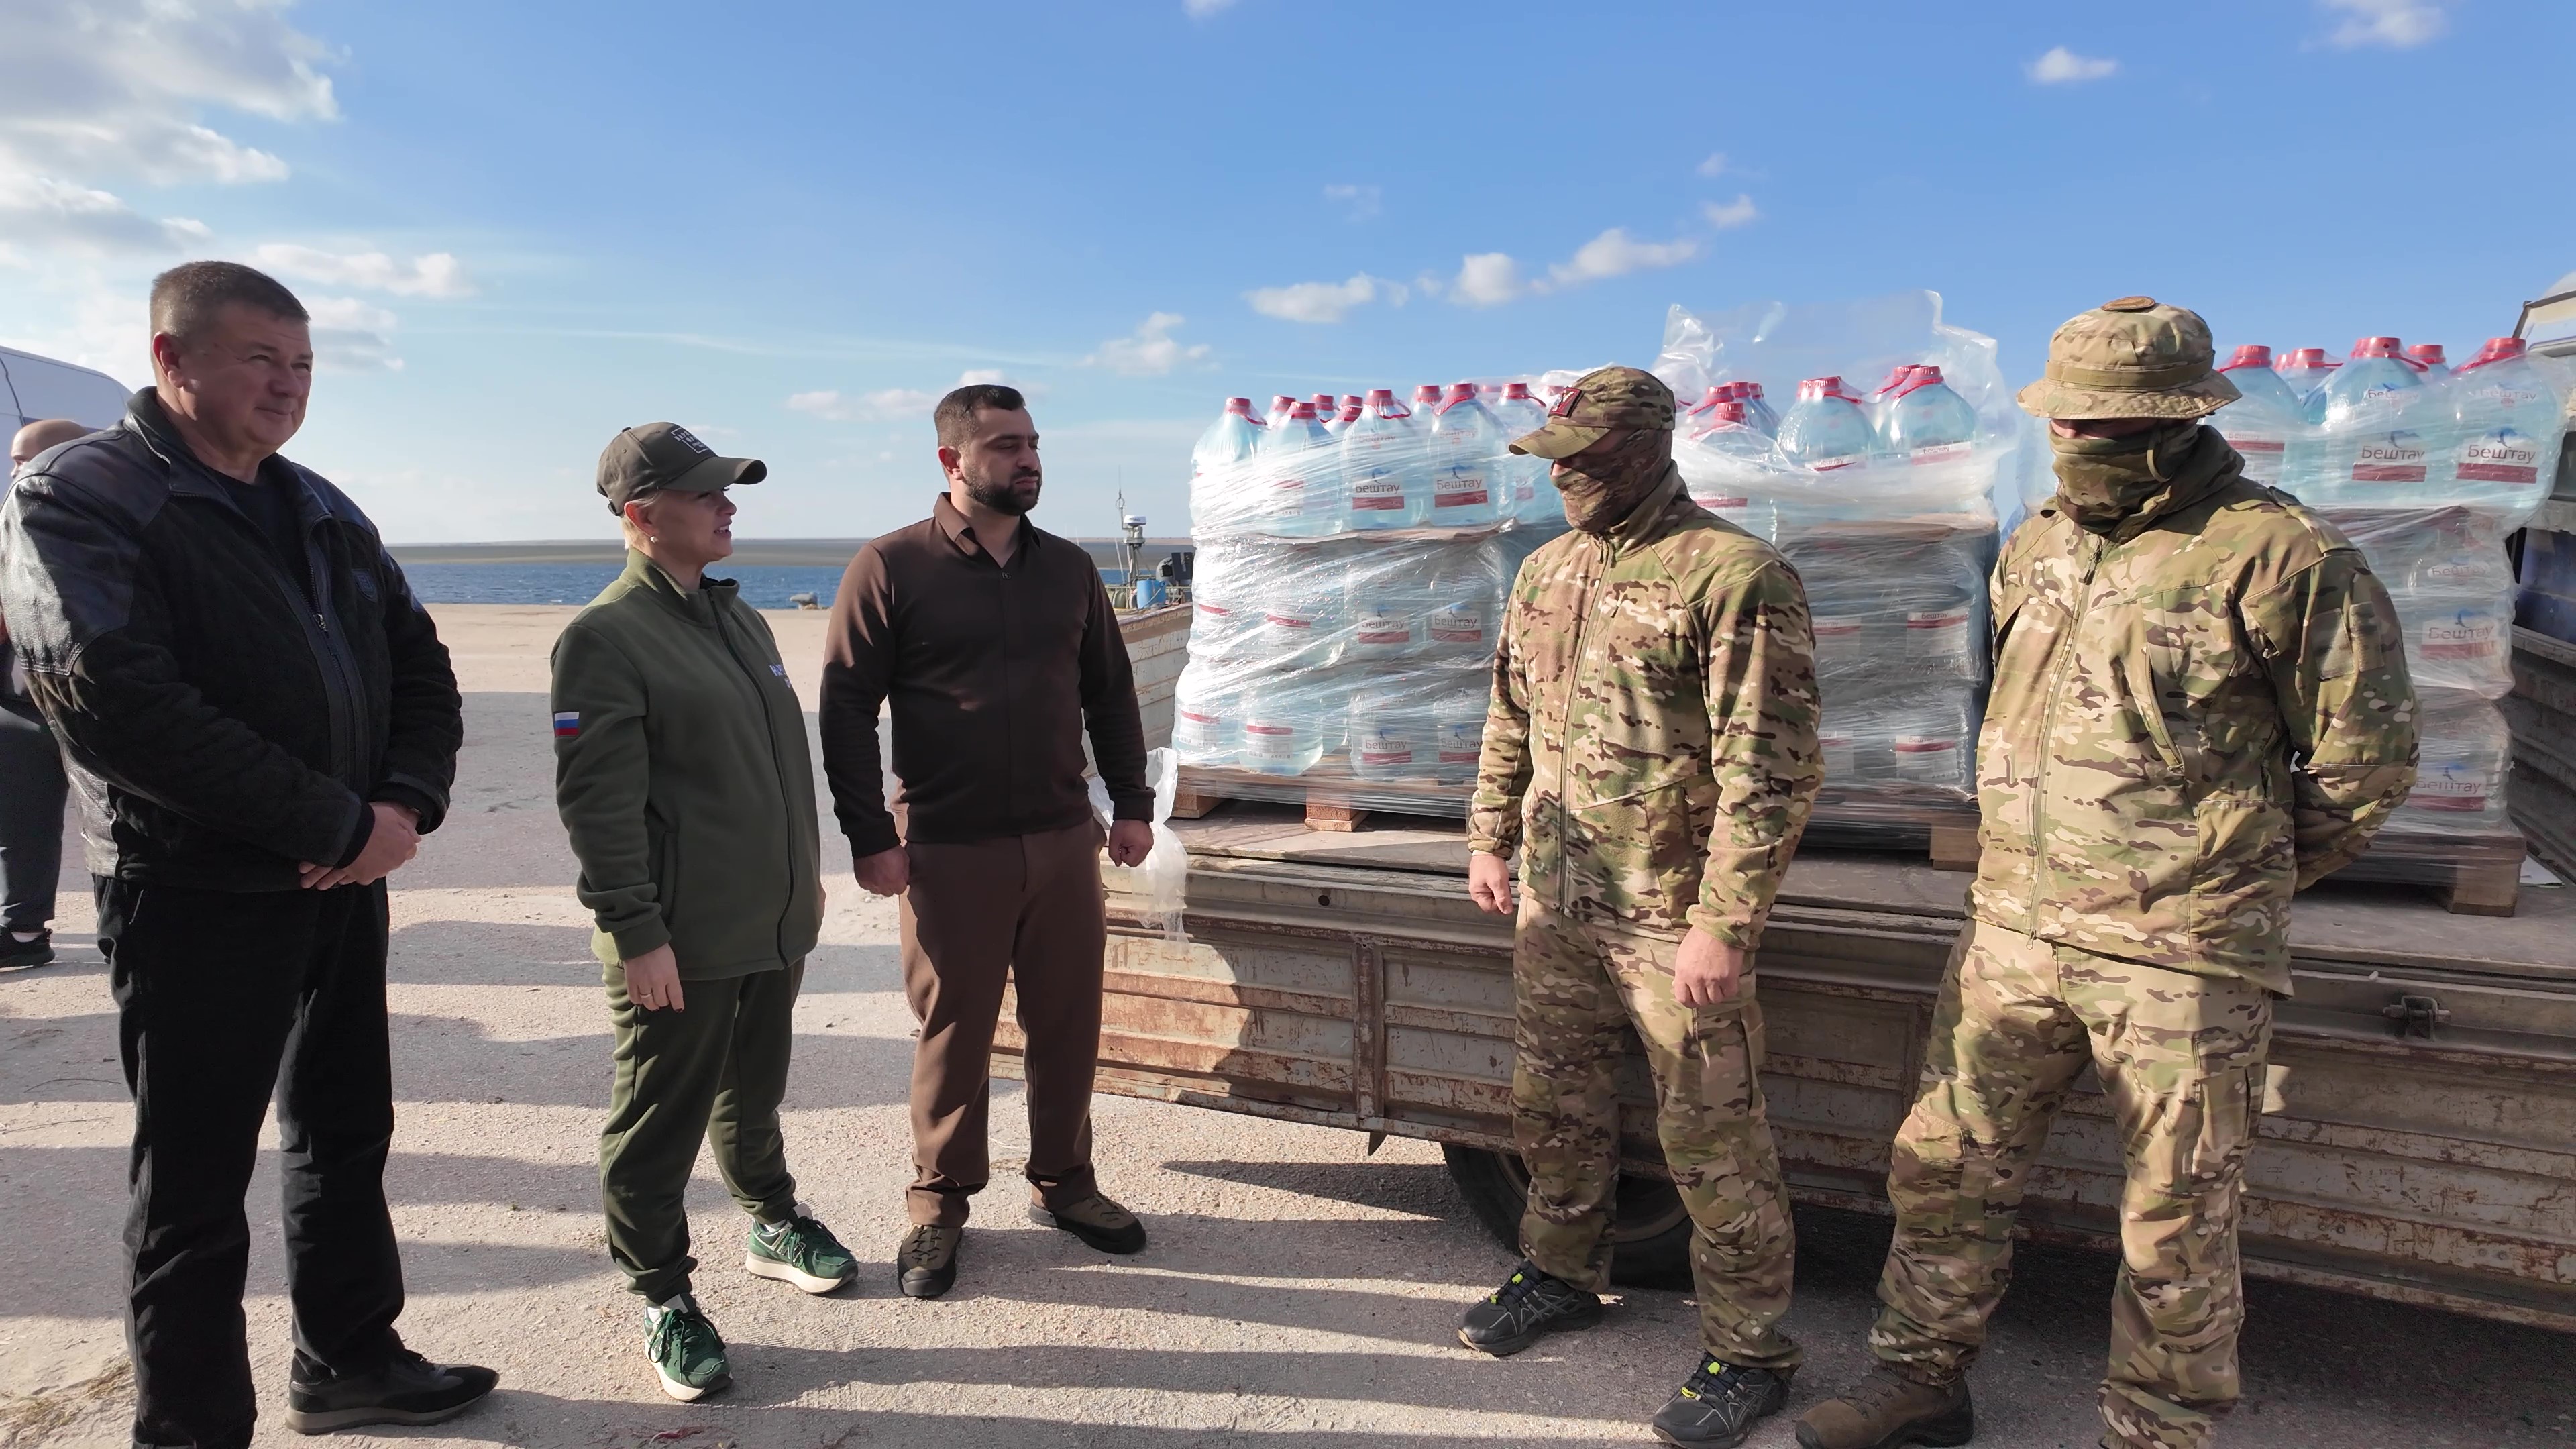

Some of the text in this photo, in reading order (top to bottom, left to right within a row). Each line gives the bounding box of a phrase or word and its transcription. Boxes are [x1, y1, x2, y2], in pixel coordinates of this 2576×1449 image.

[2361, 445, 2425, 462] Бештау
[2468, 444, 2536, 464] Бештау
[1436, 478, 1482, 490] Бештау
[1434, 615, 1477, 629] Бештау
[2428, 626, 2494, 639] Бештау
[1366, 739, 1407, 751] Бештау
[1442, 738, 1483, 750] Бештау
